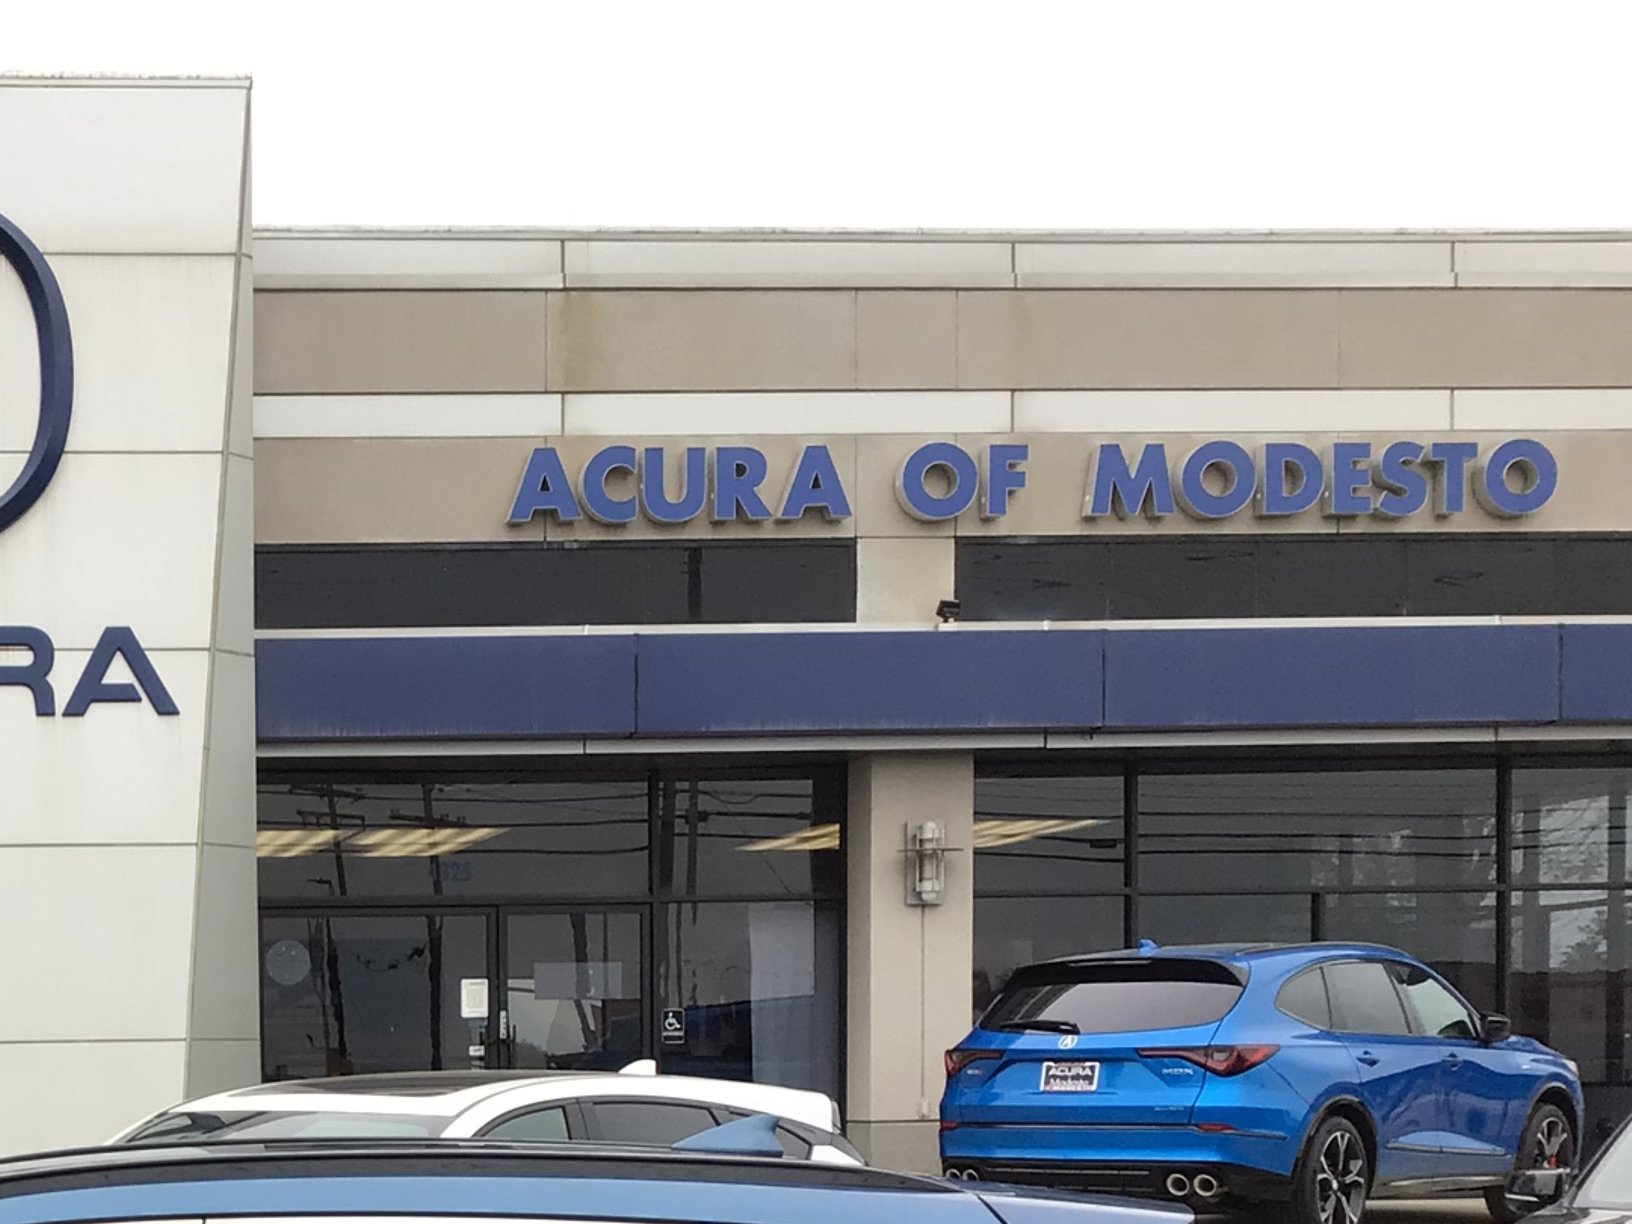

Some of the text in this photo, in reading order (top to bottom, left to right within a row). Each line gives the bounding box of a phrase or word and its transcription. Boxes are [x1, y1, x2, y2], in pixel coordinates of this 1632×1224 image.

[507, 438, 1558, 523] ACURA OF MODESTO
[1048, 1066, 1093, 1076] ACURA
